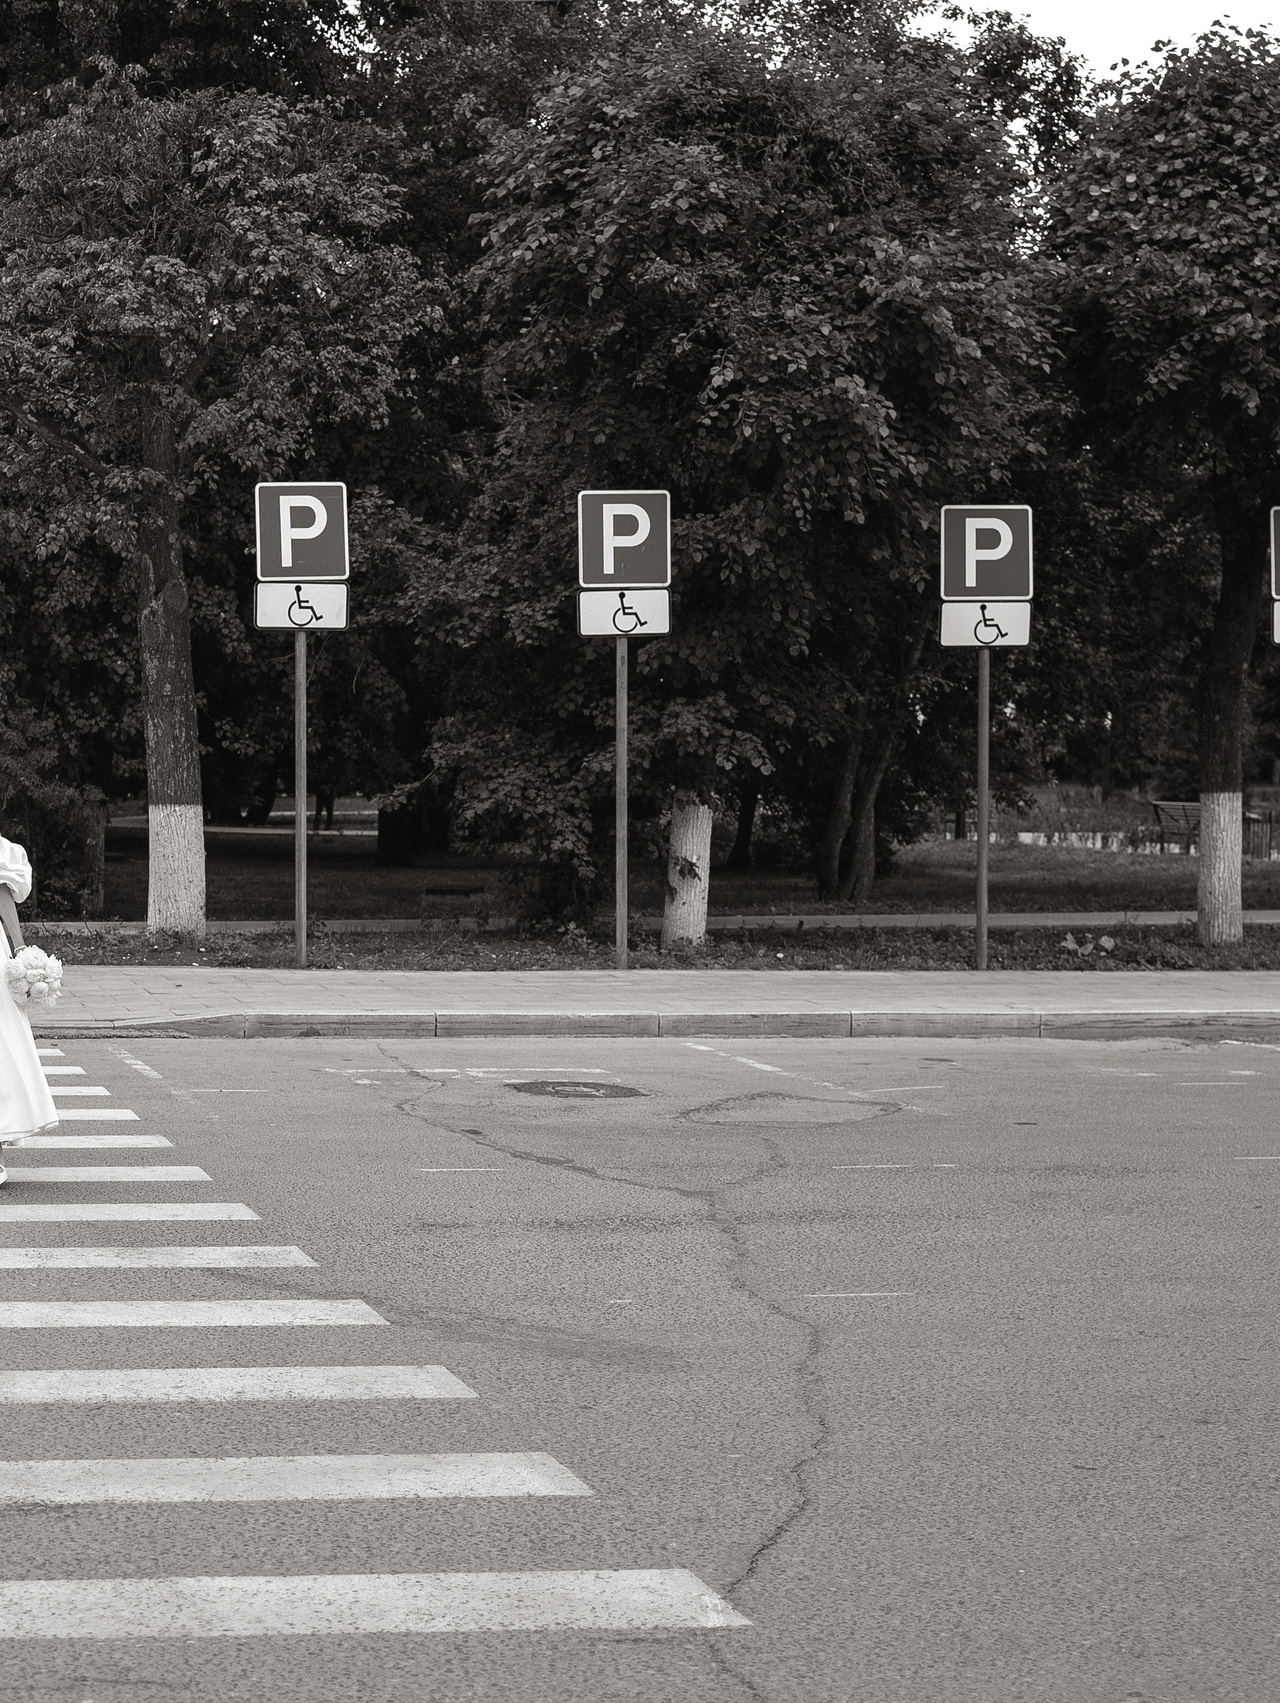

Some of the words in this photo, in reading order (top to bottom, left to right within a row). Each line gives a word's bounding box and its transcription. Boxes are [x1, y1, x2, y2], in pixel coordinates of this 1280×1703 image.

[279, 495, 328, 568] P
[602, 503, 651, 575] P
[965, 517, 1013, 587] P
